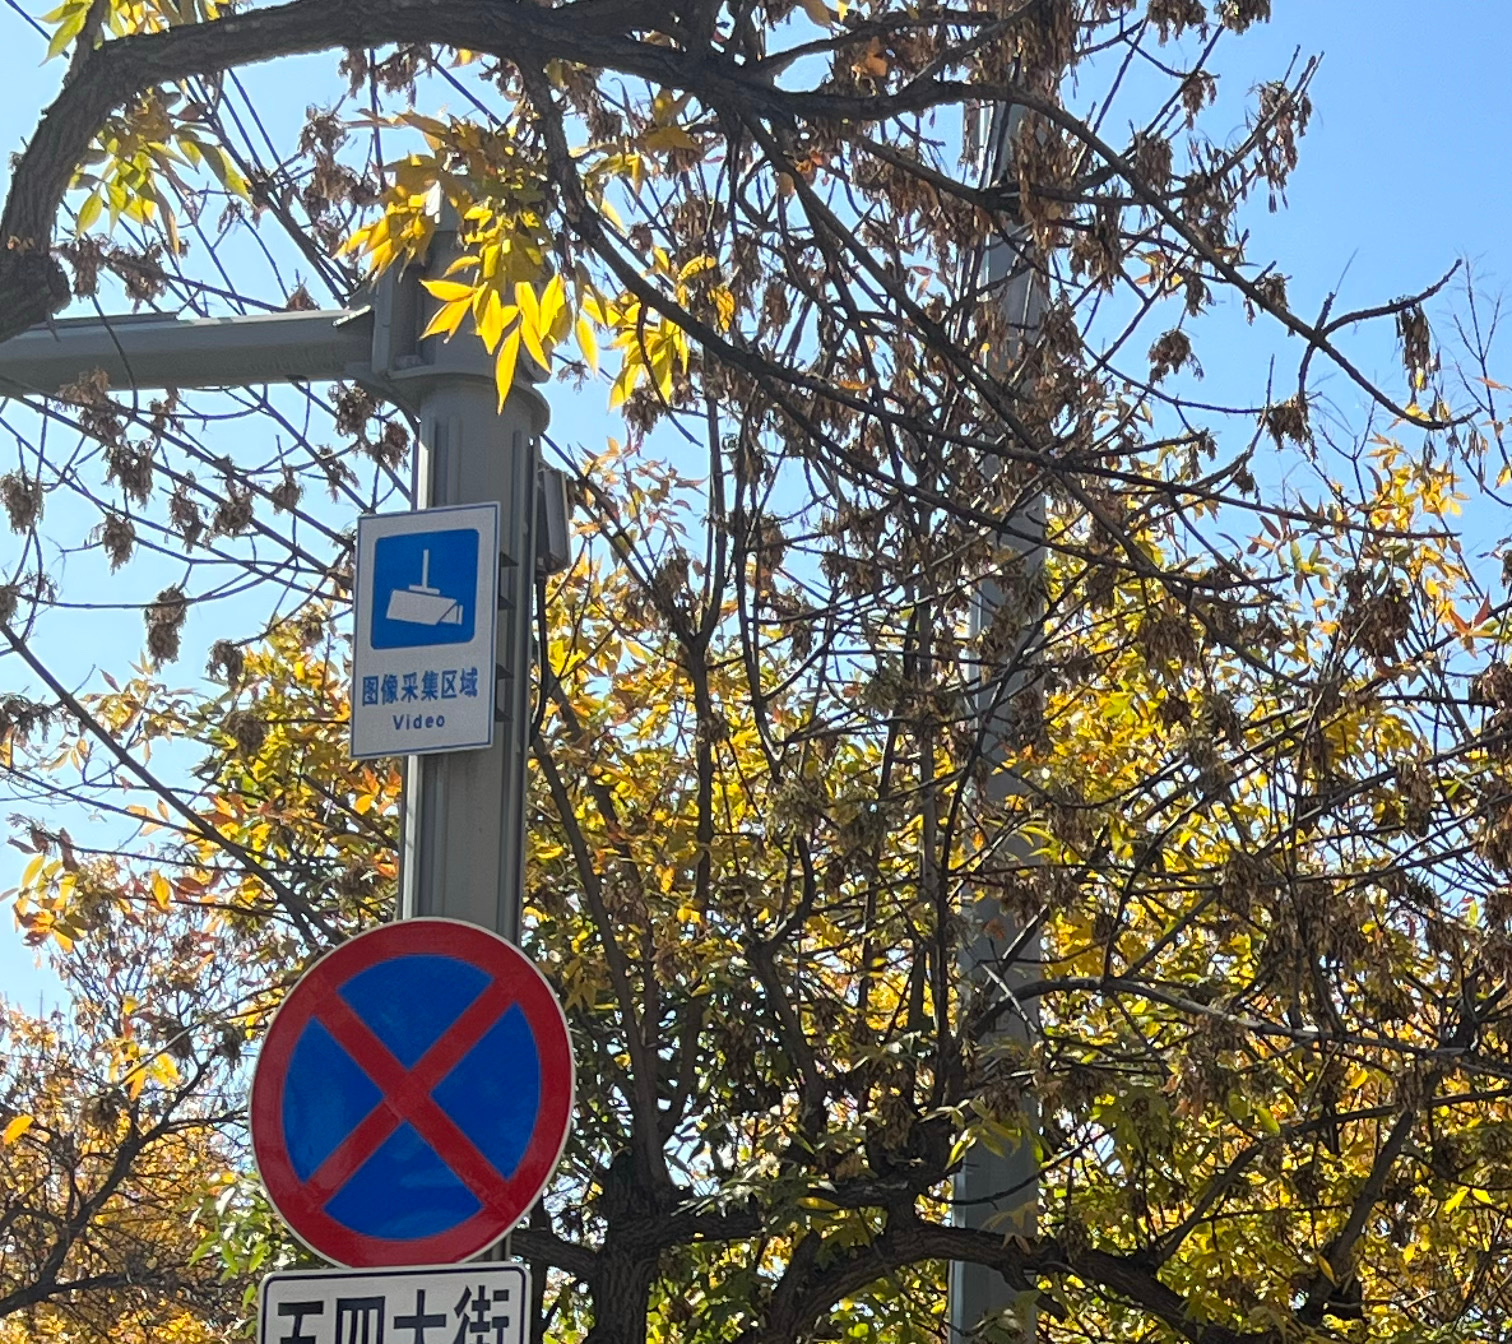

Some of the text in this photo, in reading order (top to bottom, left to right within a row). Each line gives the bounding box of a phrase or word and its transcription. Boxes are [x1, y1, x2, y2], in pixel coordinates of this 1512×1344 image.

[362, 667, 479, 707] 图像采集区域
[393, 714, 446, 731] Video
